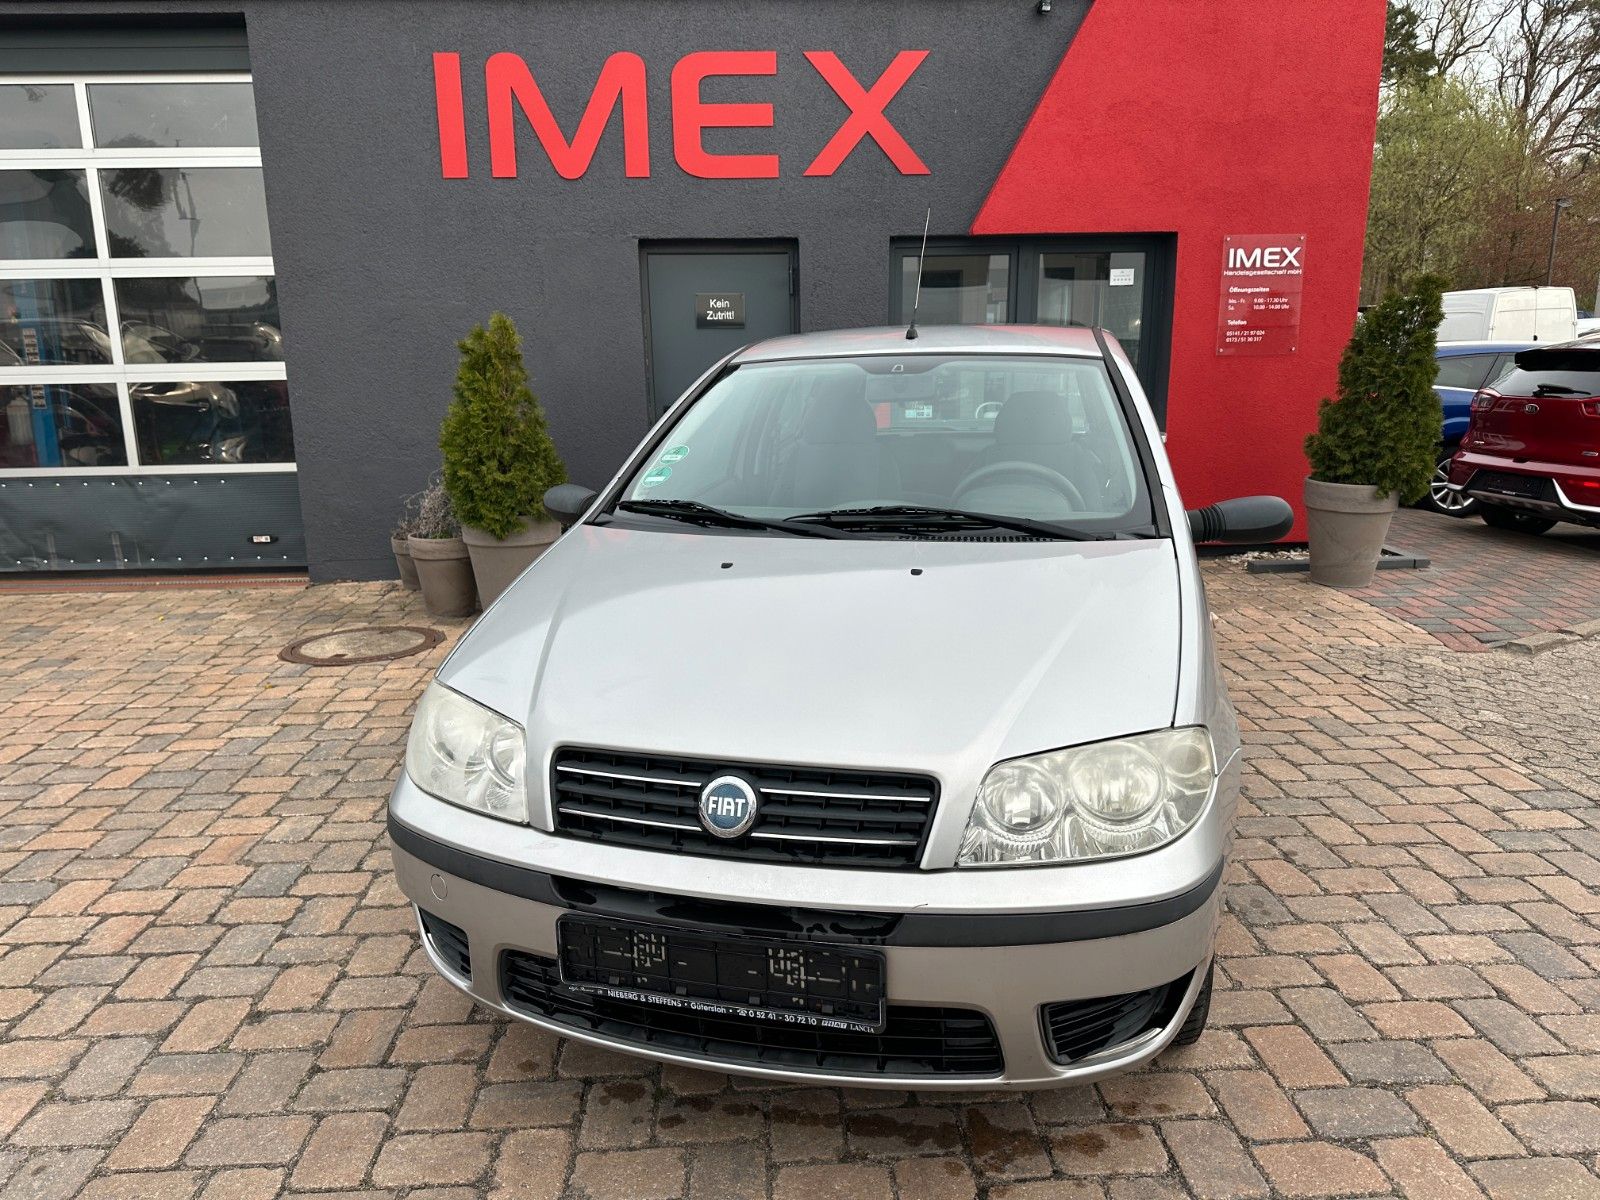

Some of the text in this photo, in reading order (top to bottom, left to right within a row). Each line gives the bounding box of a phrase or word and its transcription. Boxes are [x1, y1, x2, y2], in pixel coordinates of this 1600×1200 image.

[432, 50, 932, 180] IMEX
[1228, 247, 1302, 268] IMEX
[1229, 286, 1270, 294] Öffnungszeiten
[709, 298, 730, 308] Kein
[706, 310, 735, 320] Zutritt!
[708, 796, 746, 817] FIAT
[607, 989, 638, 1000] NIEBERG
[640, 994, 646, 1002] &
[647, 996, 682, 1007] STEFFENS
[756, 1011, 766, 1019] 52
[767, 1012, 776, 1020] 41
[784, 1014, 795, 1022] 30
[796, 1015, 806, 1024] 72
[807, 1017, 817, 1025] 10
[849, 1023, 875, 1034] LANCIA
